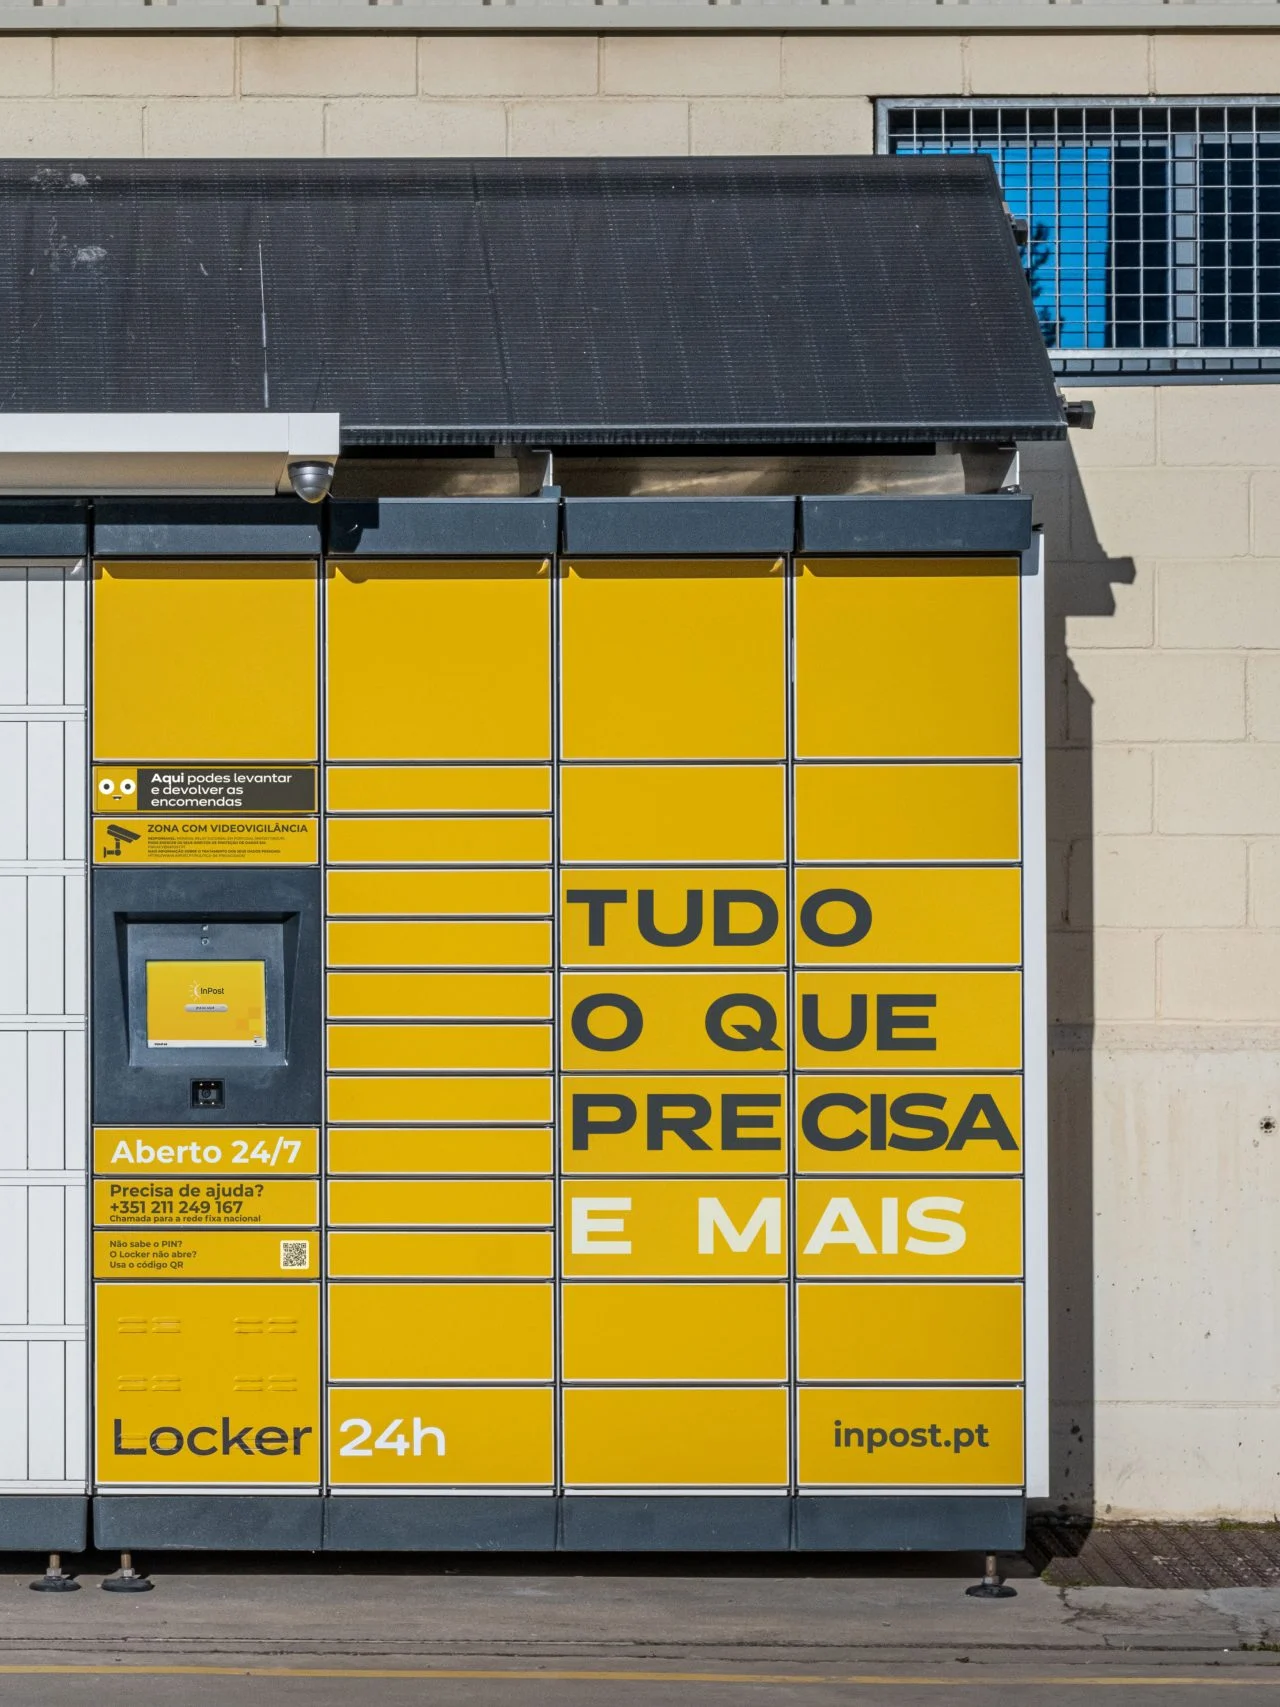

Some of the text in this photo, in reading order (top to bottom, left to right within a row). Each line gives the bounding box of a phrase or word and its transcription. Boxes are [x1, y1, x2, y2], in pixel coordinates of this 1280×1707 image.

[151, 773, 292, 785] Aqui podes levantar
[151, 785, 243, 795] e devolver as
[151, 797, 242, 807] encomendas
[148, 822, 308, 833] ZONA COM VIDEOVIGILÂNCIA
[566, 888, 873, 948] TUDO
[201, 987, 224, 995] InPost
[570, 992, 938, 1053] O QUE
[571, 1093, 1020, 1152] PRECISA
[110, 1136, 302, 1167] Aberto 24/7
[110, 1184, 264, 1200] Precisa de ajuda?
[110, 1201, 243, 1214] +351 211 249 167
[110, 1215, 151, 1223] Chamada
[154, 1216, 173, 1225] para
[183, 1215, 202, 1223] rede
[205, 1215, 221, 1223] fixa
[224, 1215, 261, 1223] nacional
[570, 1195, 968, 1257] E MAIS
[110, 1240, 127, 1248] Não
[130, 1240, 151, 1248] sabe
[162, 1240, 182, 1248] PIN?
[110, 1250, 197, 1258] O Locker não abre?
[110, 1261, 126, 1269] Usa
[136, 1260, 167, 1270] código
[170, 1261, 183, 1270] QR
[111, 1417, 446, 1457] Locker 24h
[833, 1420, 989, 1454] inpost.pt
